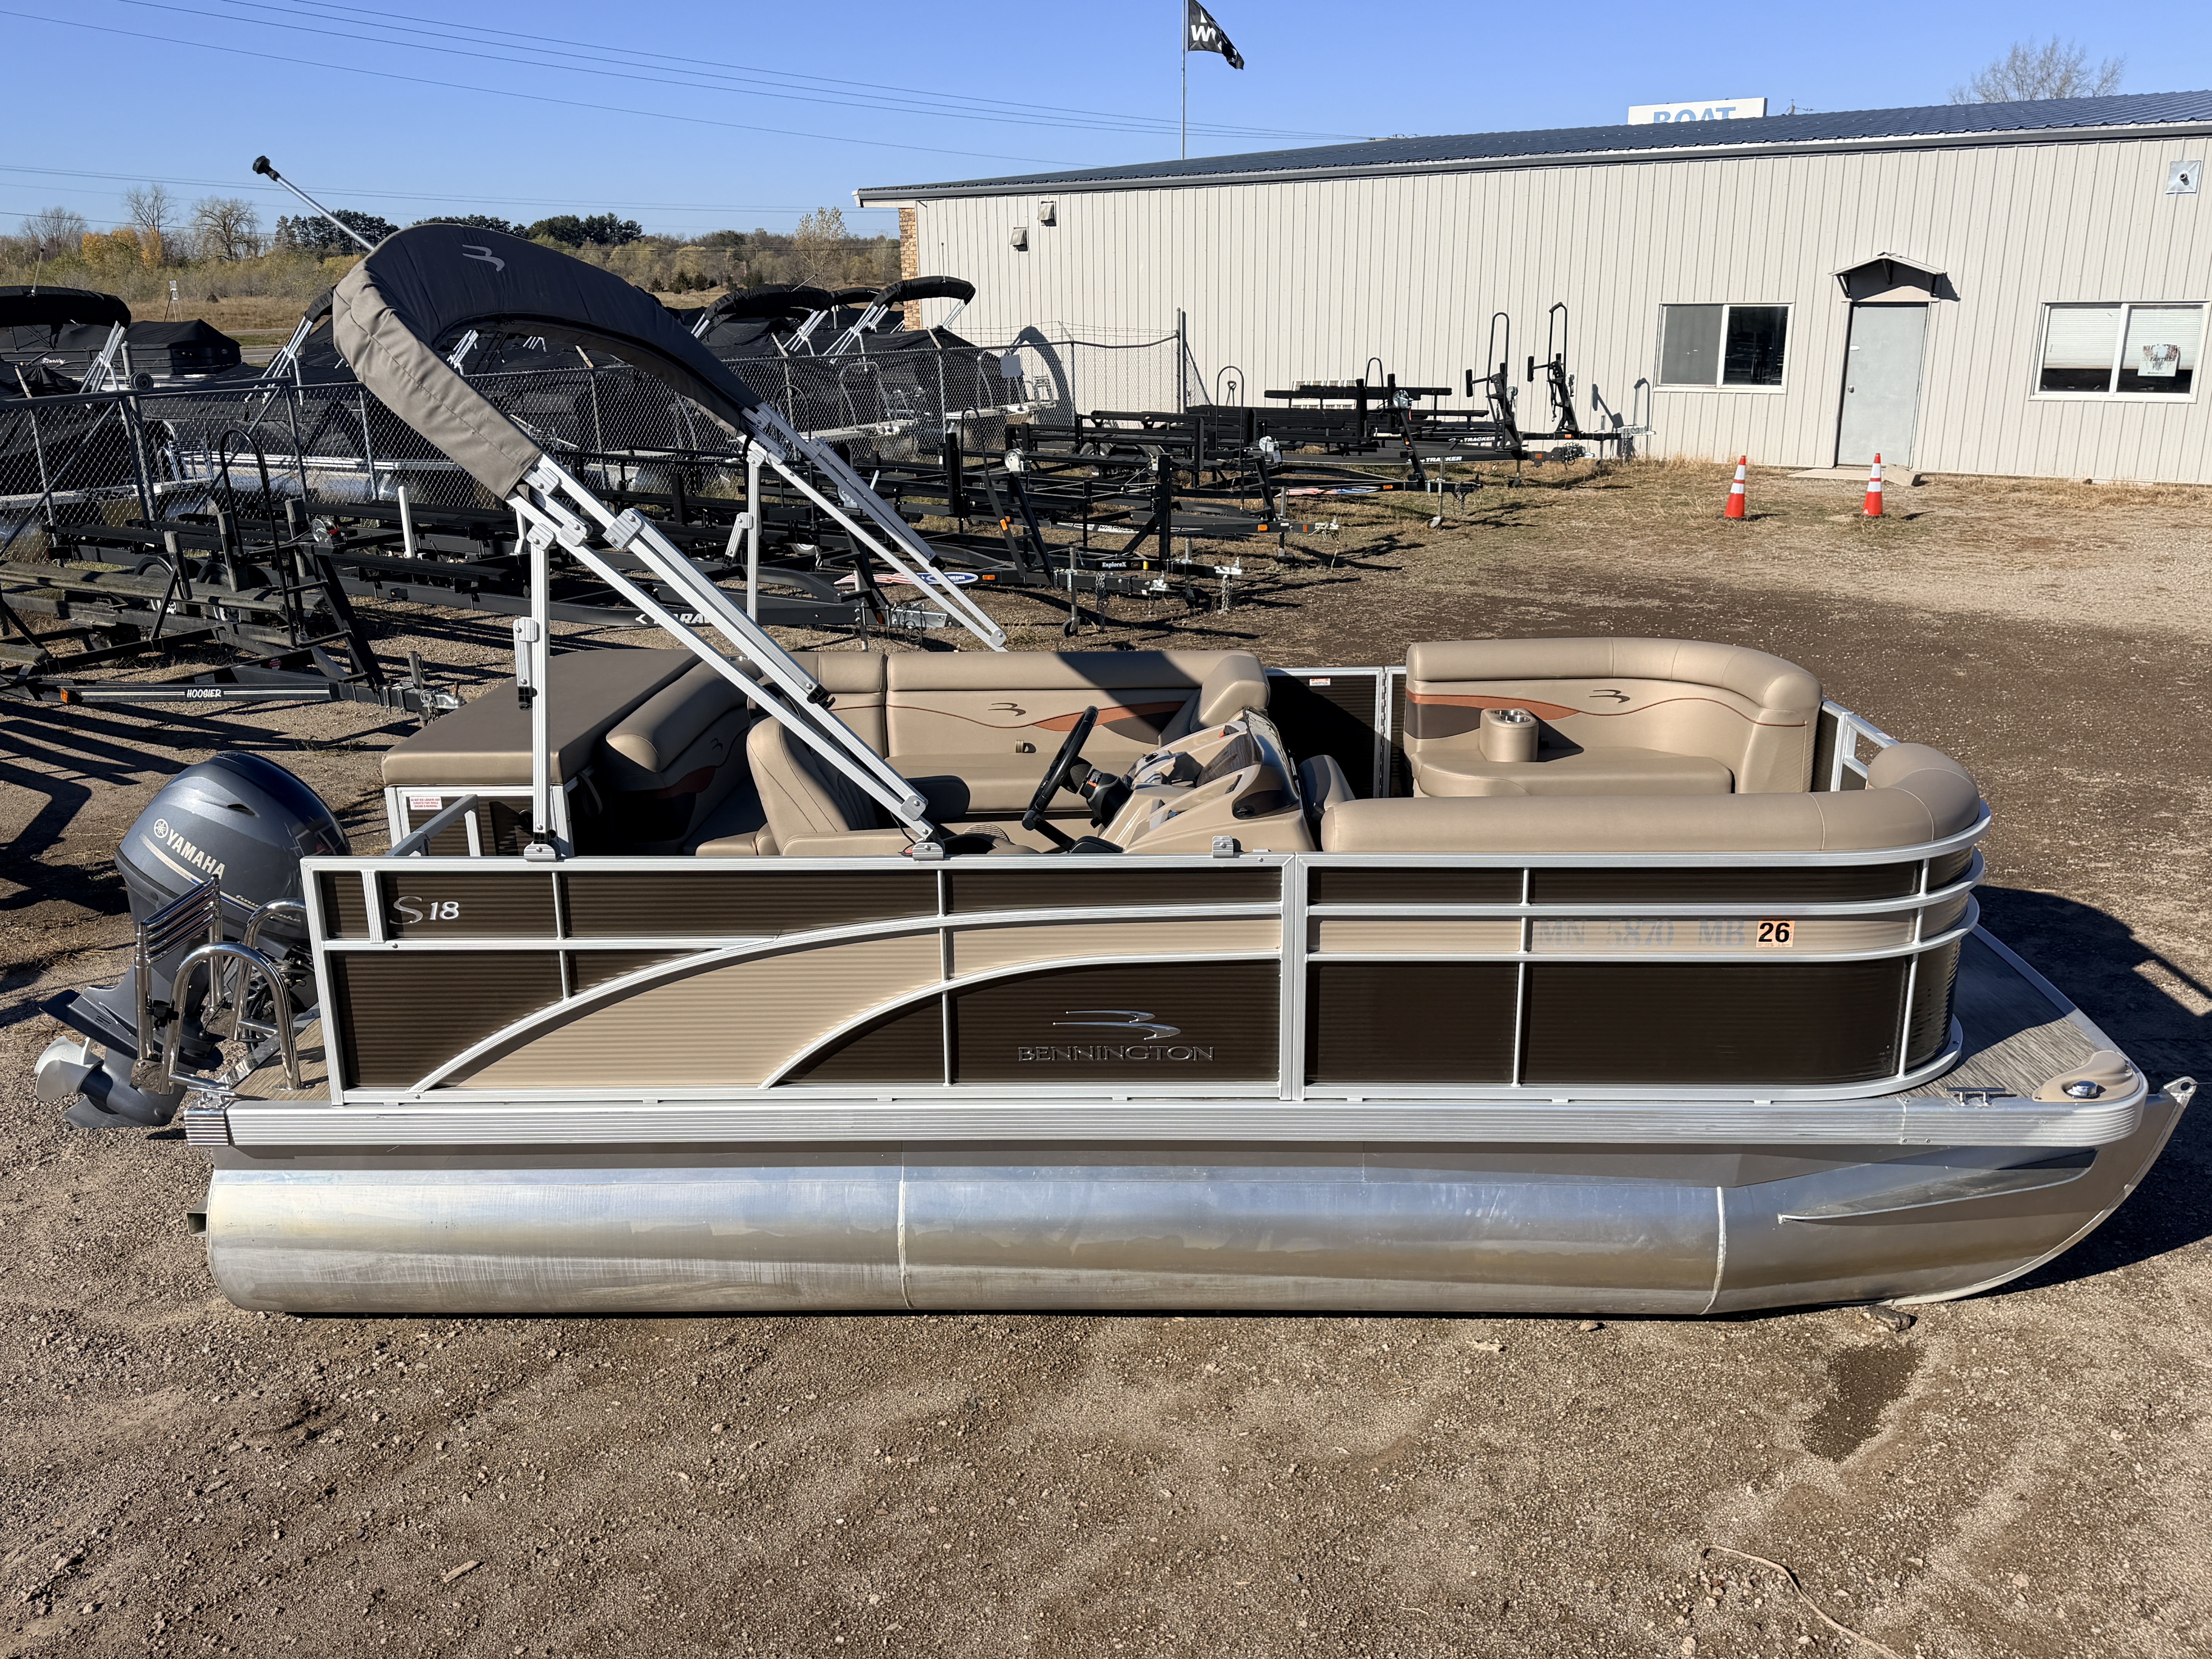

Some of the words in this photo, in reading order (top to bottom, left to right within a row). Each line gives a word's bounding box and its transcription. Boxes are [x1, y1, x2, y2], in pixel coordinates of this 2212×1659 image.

[187, 689, 221, 698] HOOSIER
[166, 829, 225, 880] YAMAHA
[1537, 919, 1587, 948] MN
[1758, 922, 1790, 943] 26
[1018, 1045, 1215, 1061] BENNINGTON
